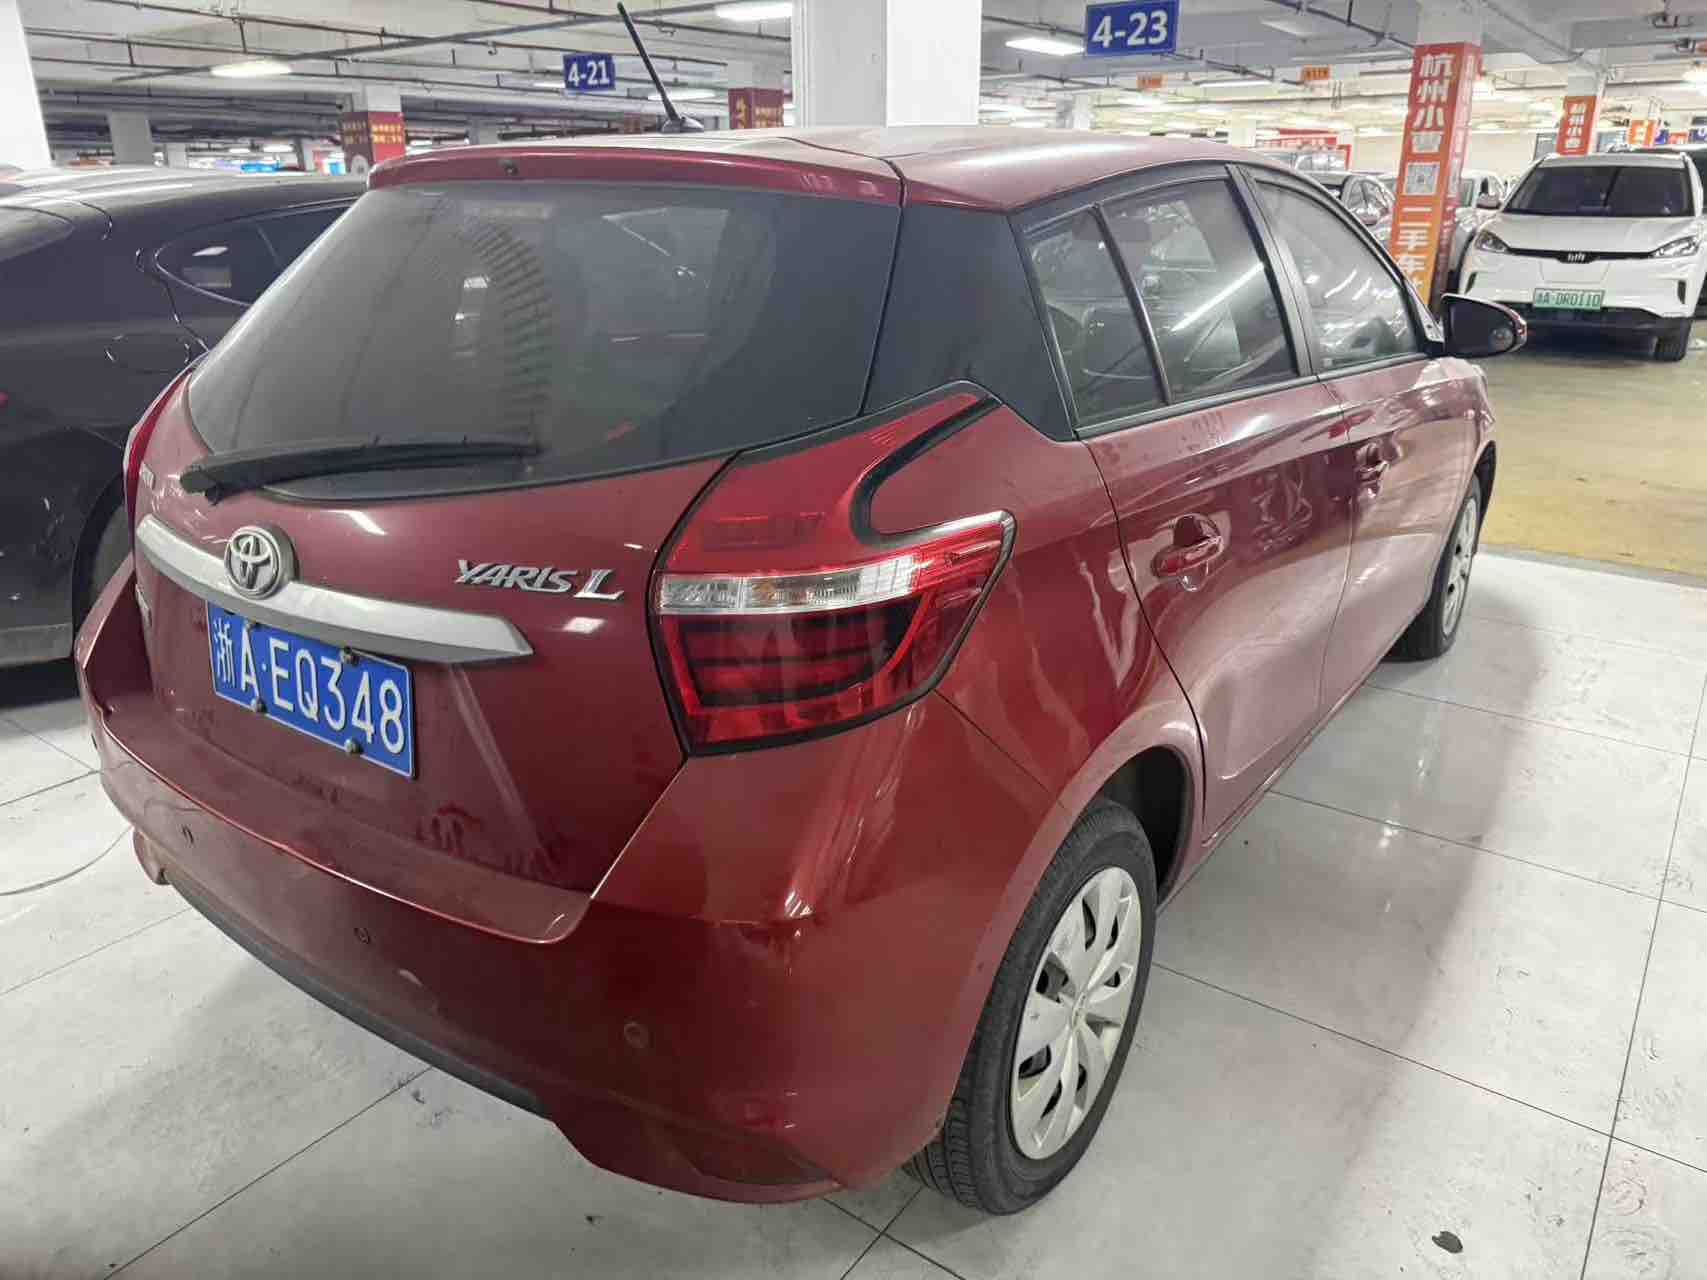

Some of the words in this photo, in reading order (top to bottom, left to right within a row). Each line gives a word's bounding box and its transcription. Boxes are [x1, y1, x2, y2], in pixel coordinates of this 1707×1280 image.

[1091, 10, 1168, 48] 4-23
[567, 60, 610, 87] 4-21
[1395, 206, 1432, 288] 二手车
[455, 559, 578, 593] YARIS
[573, 569, 625, 600] L
